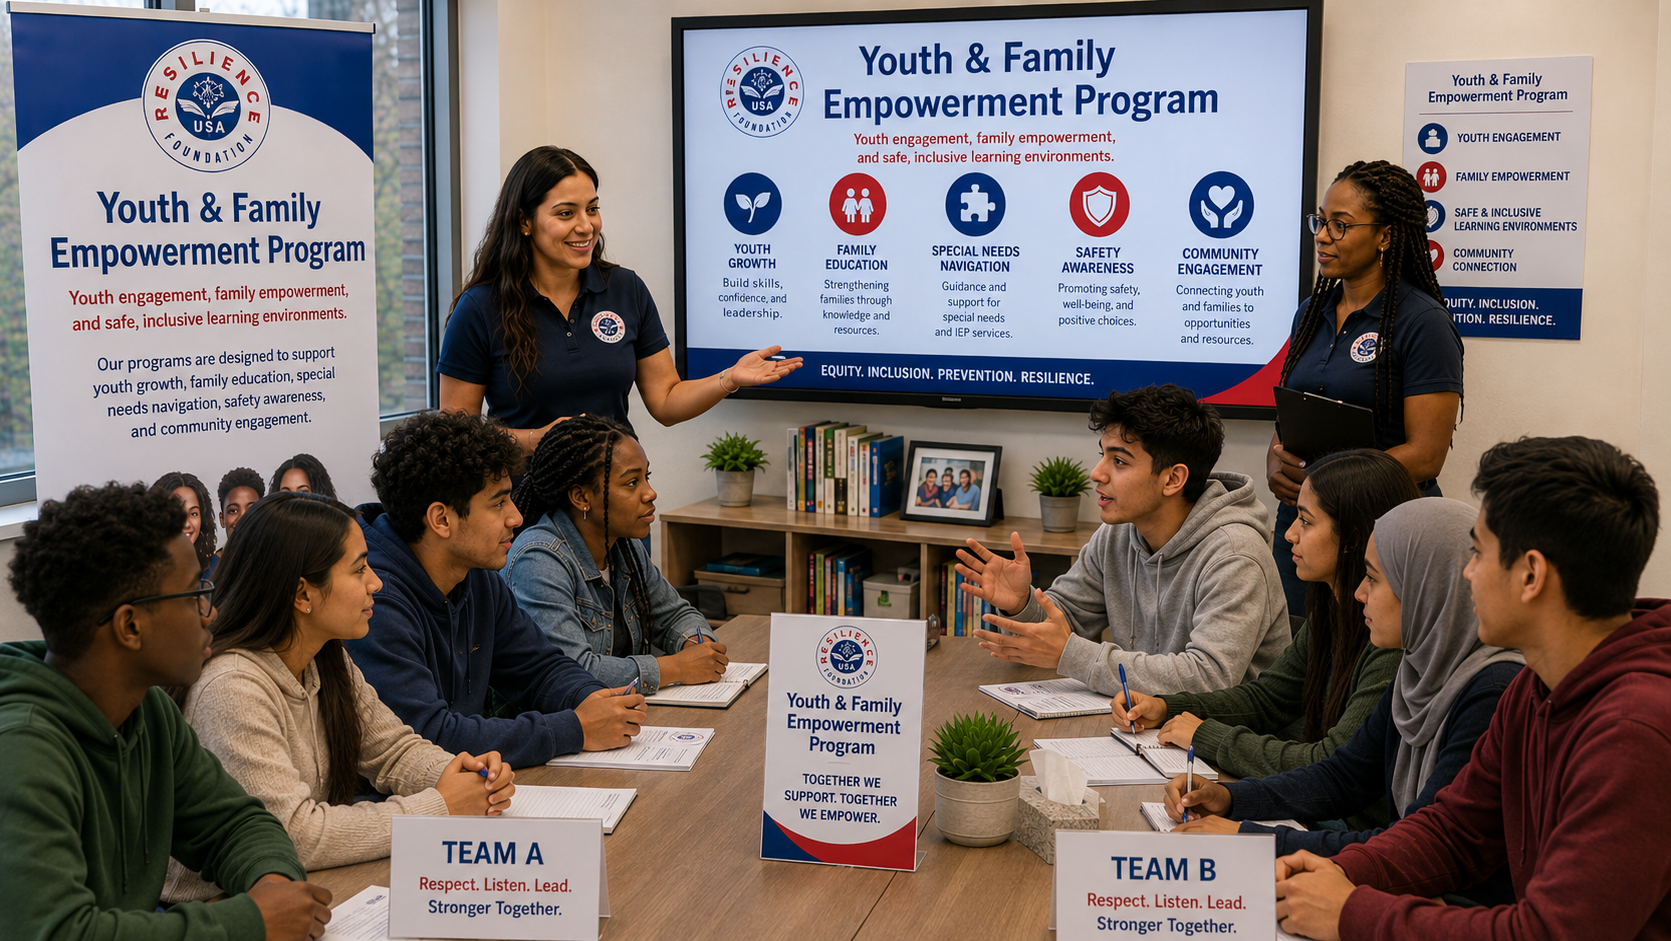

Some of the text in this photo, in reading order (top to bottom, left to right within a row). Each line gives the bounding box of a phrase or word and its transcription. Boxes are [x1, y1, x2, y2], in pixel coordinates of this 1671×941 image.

[859, 39, 1116, 78] Youth & Family
[1452, 72, 1542, 87] Youth & Family
[155, 51, 260, 124] RESILIENCE
[1429, 89, 1568, 105] Empowerment Program
[751, 101, 773, 111] USA
[824, 84, 1218, 126] Empowerment Program
[194, 120, 225, 133] USA
[733, 111, 792, 132] FOUNDATION
[854, 131, 1116, 148] Youth engagement, family empowerment,
[1457, 132, 1561, 143] YOUTH ENGAGEMENT
[164, 132, 253, 163] FOUNDATION
[857, 150, 1114, 165] and safe, inclusive learning environments.
[1456, 171, 1570, 181] FAMILY EMPOWERMENT
[96, 191, 321, 229] Youth & Family
[1455, 208, 1541, 217] SAFE & INCLUSIVE
[1454, 221, 1577, 231] LEARNING ENVIRONMENTS
[51, 235, 365, 275] Empowerment Program
[734, 243, 771, 254] YOUTH
[837, 244, 877, 255] FAMILY
[932, 245, 1020, 257] SPECIAL NEEDS
[1076, 247, 1121, 258] SAFETY
[1183, 248, 1259, 260] COMMUNITY
[1453, 248, 1514, 258] COMMUNITY
[728, 258, 776, 269] GROWTH
[826, 259, 888, 270] EDUCATION
[941, 260, 1010, 272] NAVIGATION
[1062, 262, 1134, 274] AWARENESS
[1178, 263, 1263, 276] ENGAGEMENT
[1453, 262, 1517, 272] CONNECTION
[723, 277, 783, 289] Build skills,
[824, 279, 889, 292] Strengthening
[942, 281, 1006, 292] Guidance and
[1058, 283, 1140, 296] Promoting safety,
[69, 284, 348, 307] Youth engagement, family empowerment,
[1176, 284, 1264, 298] Connecting youth
[718, 292, 787, 304] confidence, and
[820, 294, 892, 308] families through
[948, 297, 1001, 309] support for
[1444, 298, 1539, 310] QUITY. INCLUSION.
[1063, 299, 1134, 312] well-being, and
[1182, 301, 1254, 312] and families to
[73, 307, 347, 331] and safe, inclusive learning environments.
[723, 307, 782, 320] leadership.
[823, 310, 890, 322] knowledge and
[943, 311, 1005, 324] special needs
[1489, 314, 1556, 325] RESILIENCE.
[1059, 315, 1136, 327] positive choices.
[1184, 318, 1251, 330] opportunities
[834, 327, 879, 335] resources.
[935, 327, 1013, 338] and IEP services.
[1181, 333, 1254, 345] and resources.
[97, 346, 335, 373] Our programs are designed to support
[821, 365, 1094, 385] EQUITY. INCLUSION. PREVENTION. RESILIENCE.
[93, 366, 335, 399] youth growth, family education, special
[108, 391, 325, 417] needs navigation, safety awareness,
[131, 412, 311, 438] and community engagement.
[820, 630, 873, 667] RESILIENCE
[838, 663, 855, 671] USA
[787, 692, 902, 717] Youth & Family
[787, 713, 901, 735] Empowerment
[809, 736, 875, 757] Program
[802, 773, 881, 788] TOGETHER WE
[784, 790, 897, 807] SUPPORT. TOGETHER
[799, 808, 880, 823] WE EMPOWER.
[442, 841, 544, 865] TEAM A
[1111, 856, 1216, 881] TEAM B
[420, 877, 572, 894] Respect. Listen. Lead.
[1088, 893, 1246, 910] Respect. Listen. Lead.
[428, 899, 562, 918] Stronger Together.
[1097, 916, 1236, 936] Stronger Together.
